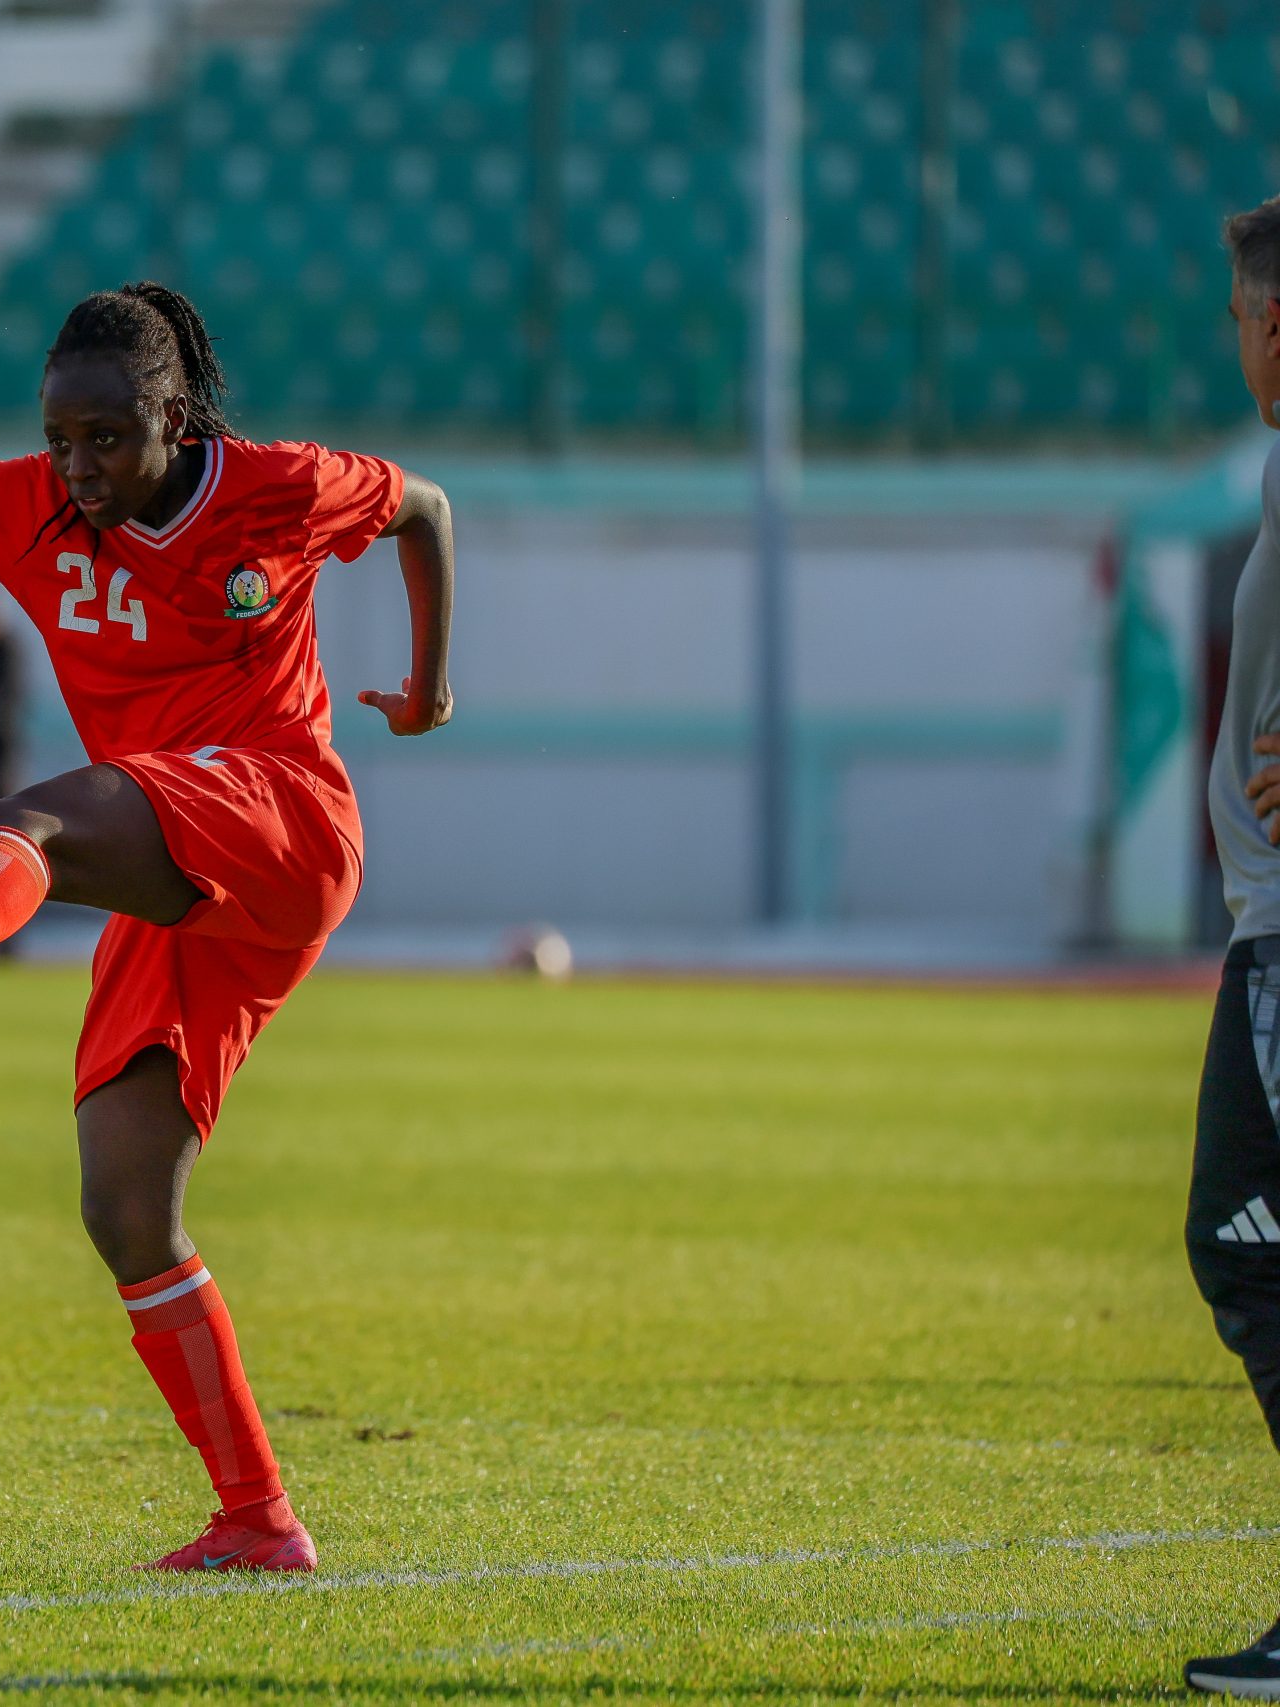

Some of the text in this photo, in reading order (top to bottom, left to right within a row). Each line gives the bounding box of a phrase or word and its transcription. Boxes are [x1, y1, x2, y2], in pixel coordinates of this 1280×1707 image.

[57, 552, 147, 641] 24
[226, 573, 237, 608] FOOTBALL
[260, 571, 269, 594] KENYA
[236, 603, 271, 618] FEDERATION
